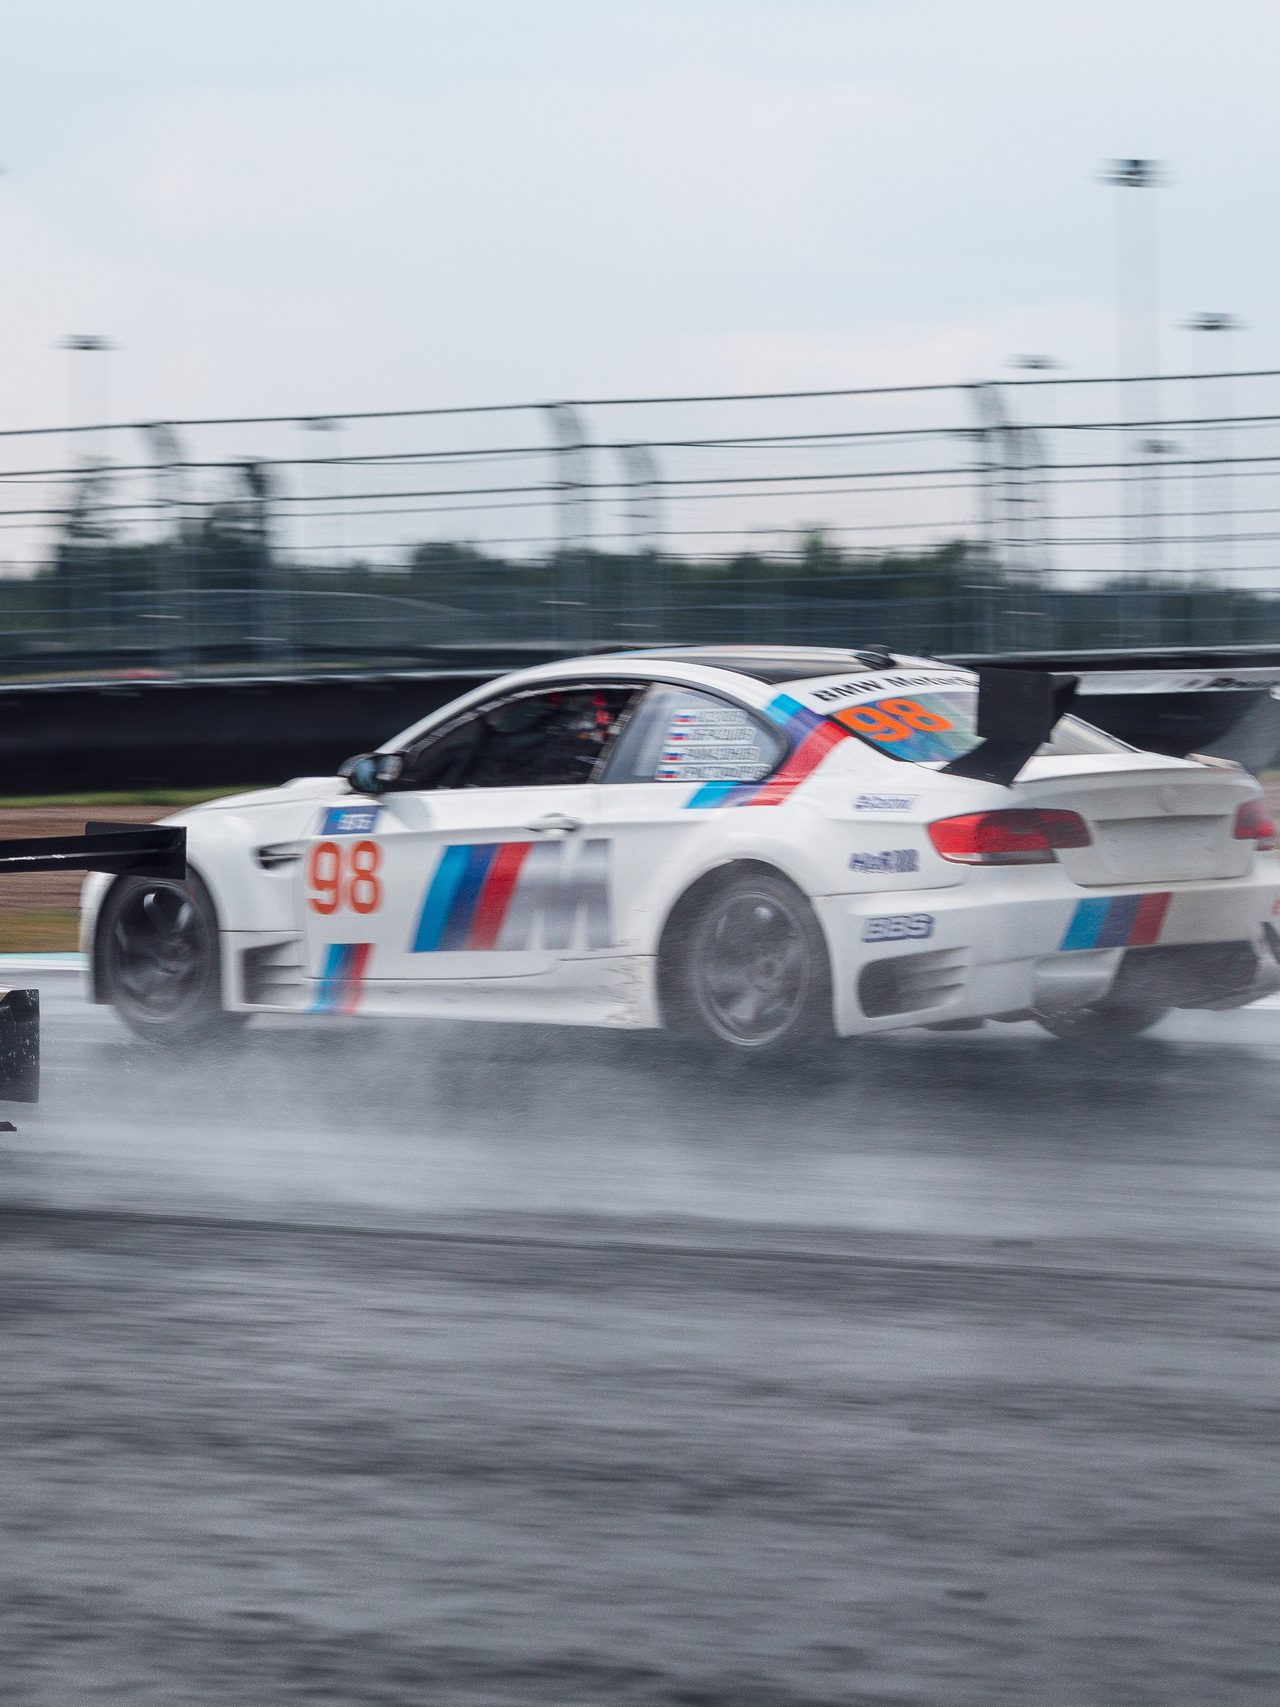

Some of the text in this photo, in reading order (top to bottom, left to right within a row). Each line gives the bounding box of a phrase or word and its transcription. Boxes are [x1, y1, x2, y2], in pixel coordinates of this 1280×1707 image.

[812, 679, 884, 702] BMW
[833, 698, 955, 742] 98
[306, 841, 384, 914] 98
